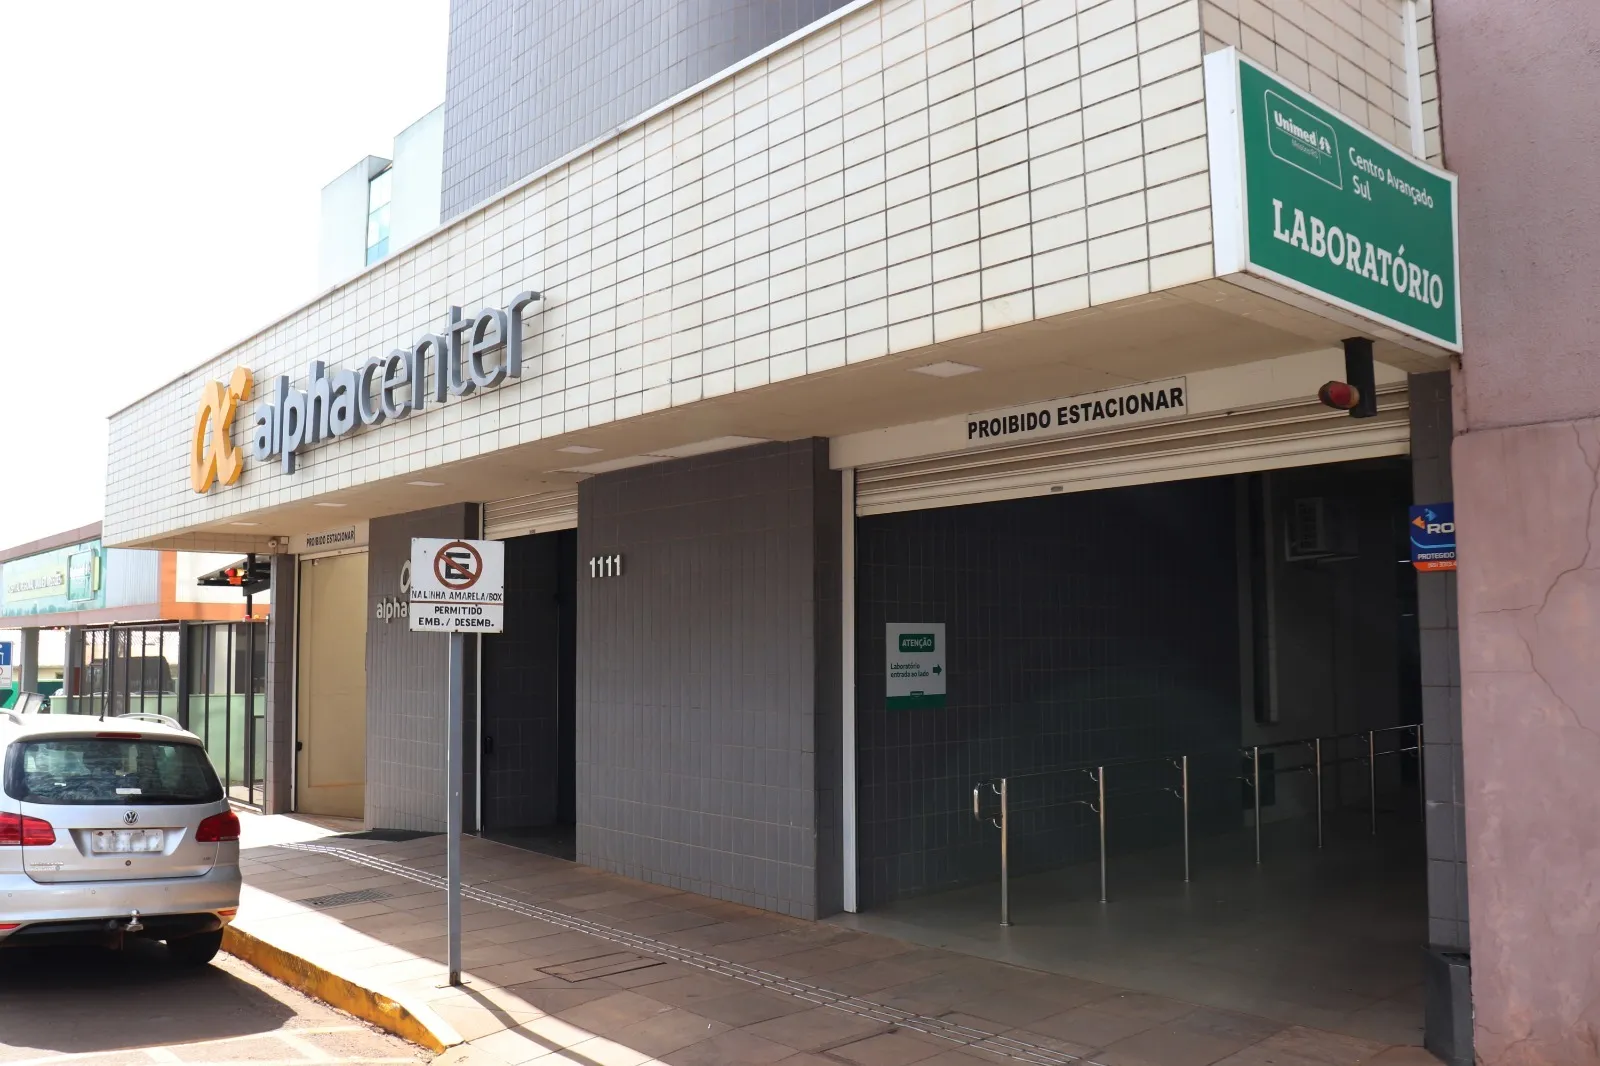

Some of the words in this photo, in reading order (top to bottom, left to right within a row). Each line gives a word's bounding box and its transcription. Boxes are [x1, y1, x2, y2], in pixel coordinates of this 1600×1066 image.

[1273, 110, 1317, 146] Unimed
[1348, 147, 1385, 181] Centro
[1387, 168, 1434, 208] Avançado
[1352, 175, 1372, 201] Sul
[1272, 198, 1444, 309] LABORATÓRIO
[252, 290, 541, 475] alphacenter
[967, 409, 1051, 439] PROIBIDO
[1056, 387, 1185, 426] ESTACIONAR
[306, 535, 326, 547] PROIBIDO
[326, 530, 354, 543] ESTACIONAR
[1417, 551, 1455, 560] PROTEGIDO
[589, 554, 621, 578] 1111
[411, 590, 423, 599] NA
[448, 591, 503, 602] AMARELA/BOX
[376, 597, 410, 624] alpha
[434, 606, 482, 615] PERMITIDO
[454, 618, 495, 627] DESEMB.
[902, 637, 932, 648] ATENÇÃO
[890, 662, 920, 670] Laboratório
[890, 670, 911, 678] entrada
[917, 669, 929, 677] lado
